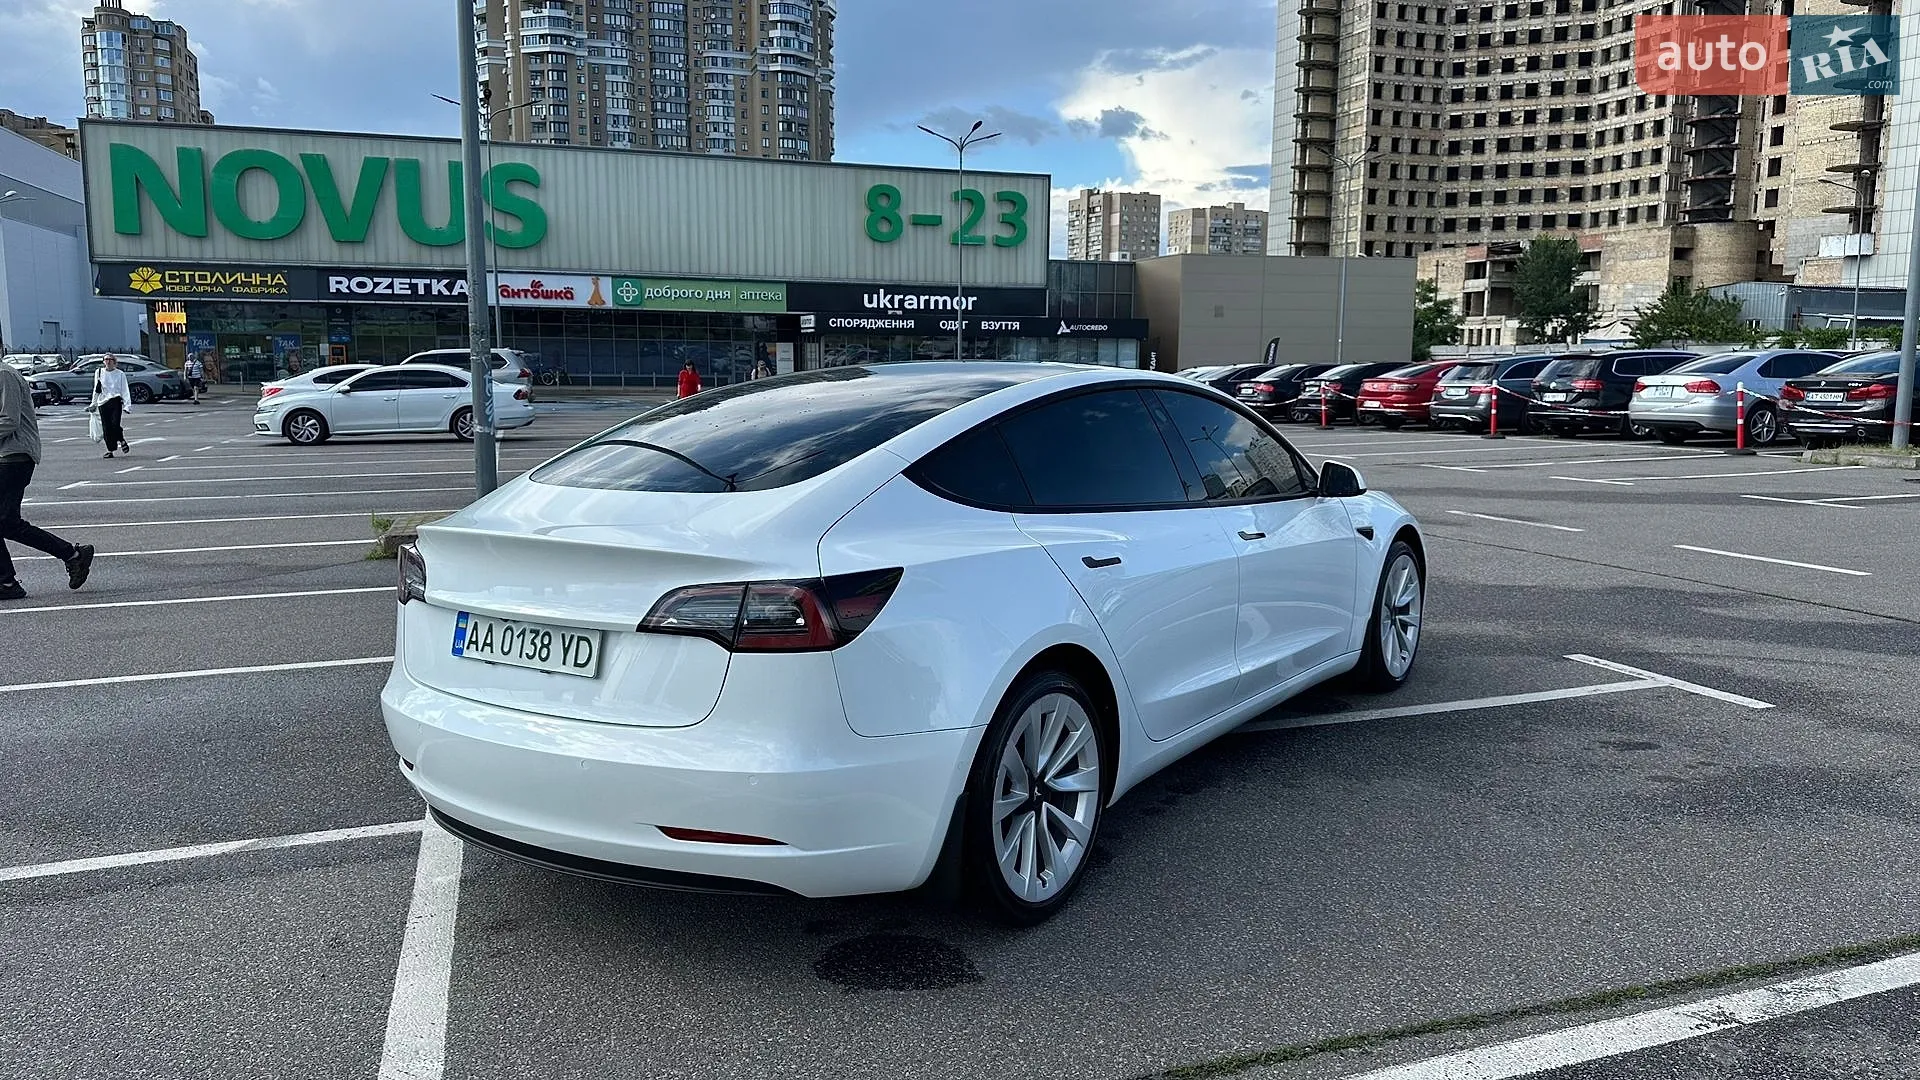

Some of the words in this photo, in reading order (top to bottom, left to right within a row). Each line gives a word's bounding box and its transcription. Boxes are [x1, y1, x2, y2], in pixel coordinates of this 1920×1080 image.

[109, 142, 548, 249] NOVUS
[165, 270, 288, 286] СТОЛИЧНА
[328, 276, 470, 296] ROZETKA
[165, 285, 225, 293] ЮВЕЛІРНА
[231, 286, 288, 294] ФАБРИКА
[644, 285, 703, 300] доброго
[705, 290, 731, 301] дня
[739, 290, 783, 301] аптека
[863, 288, 977, 311] ukrarmor
[828, 318, 915, 330] СПОРЯДЖЕННЯ
[939, 320, 968, 331] ОДЯГ
[981, 321, 1020, 331] ВЗУТТЯ
[455, 639, 464, 649] UA
[466, 621, 495, 654] AA
[500, 624, 552, 662] 0138
[560, 632, 593, 668] YD
